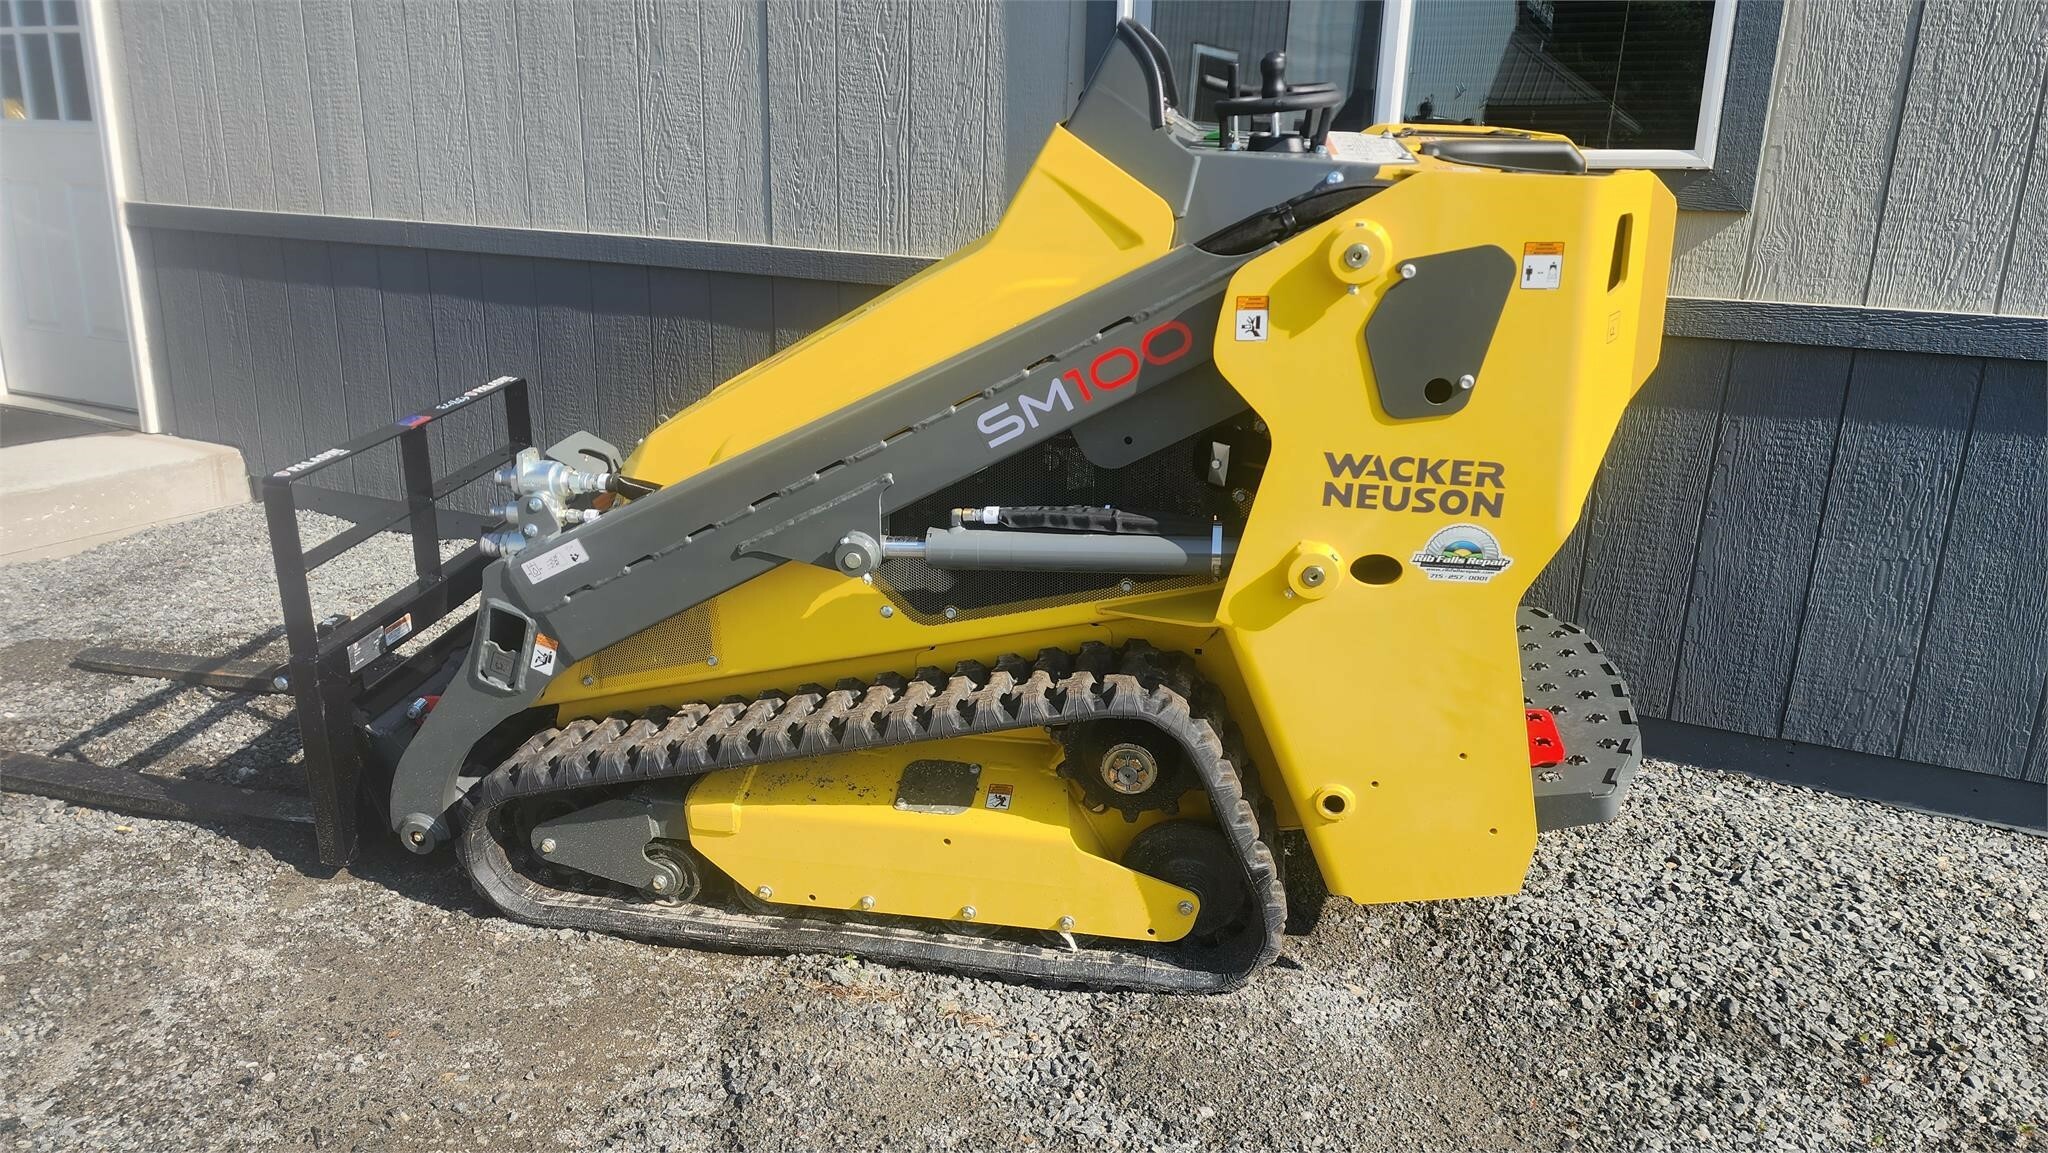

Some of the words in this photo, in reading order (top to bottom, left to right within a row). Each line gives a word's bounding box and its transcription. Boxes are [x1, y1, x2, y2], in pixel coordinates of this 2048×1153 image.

[977, 320, 1192, 448] SM100
[1324, 452, 1506, 489] WACKER
[1322, 481, 1505, 518] NEUSON
[1436, 555, 1466, 564] Falls
[1466, 557, 1509, 567] Repair
